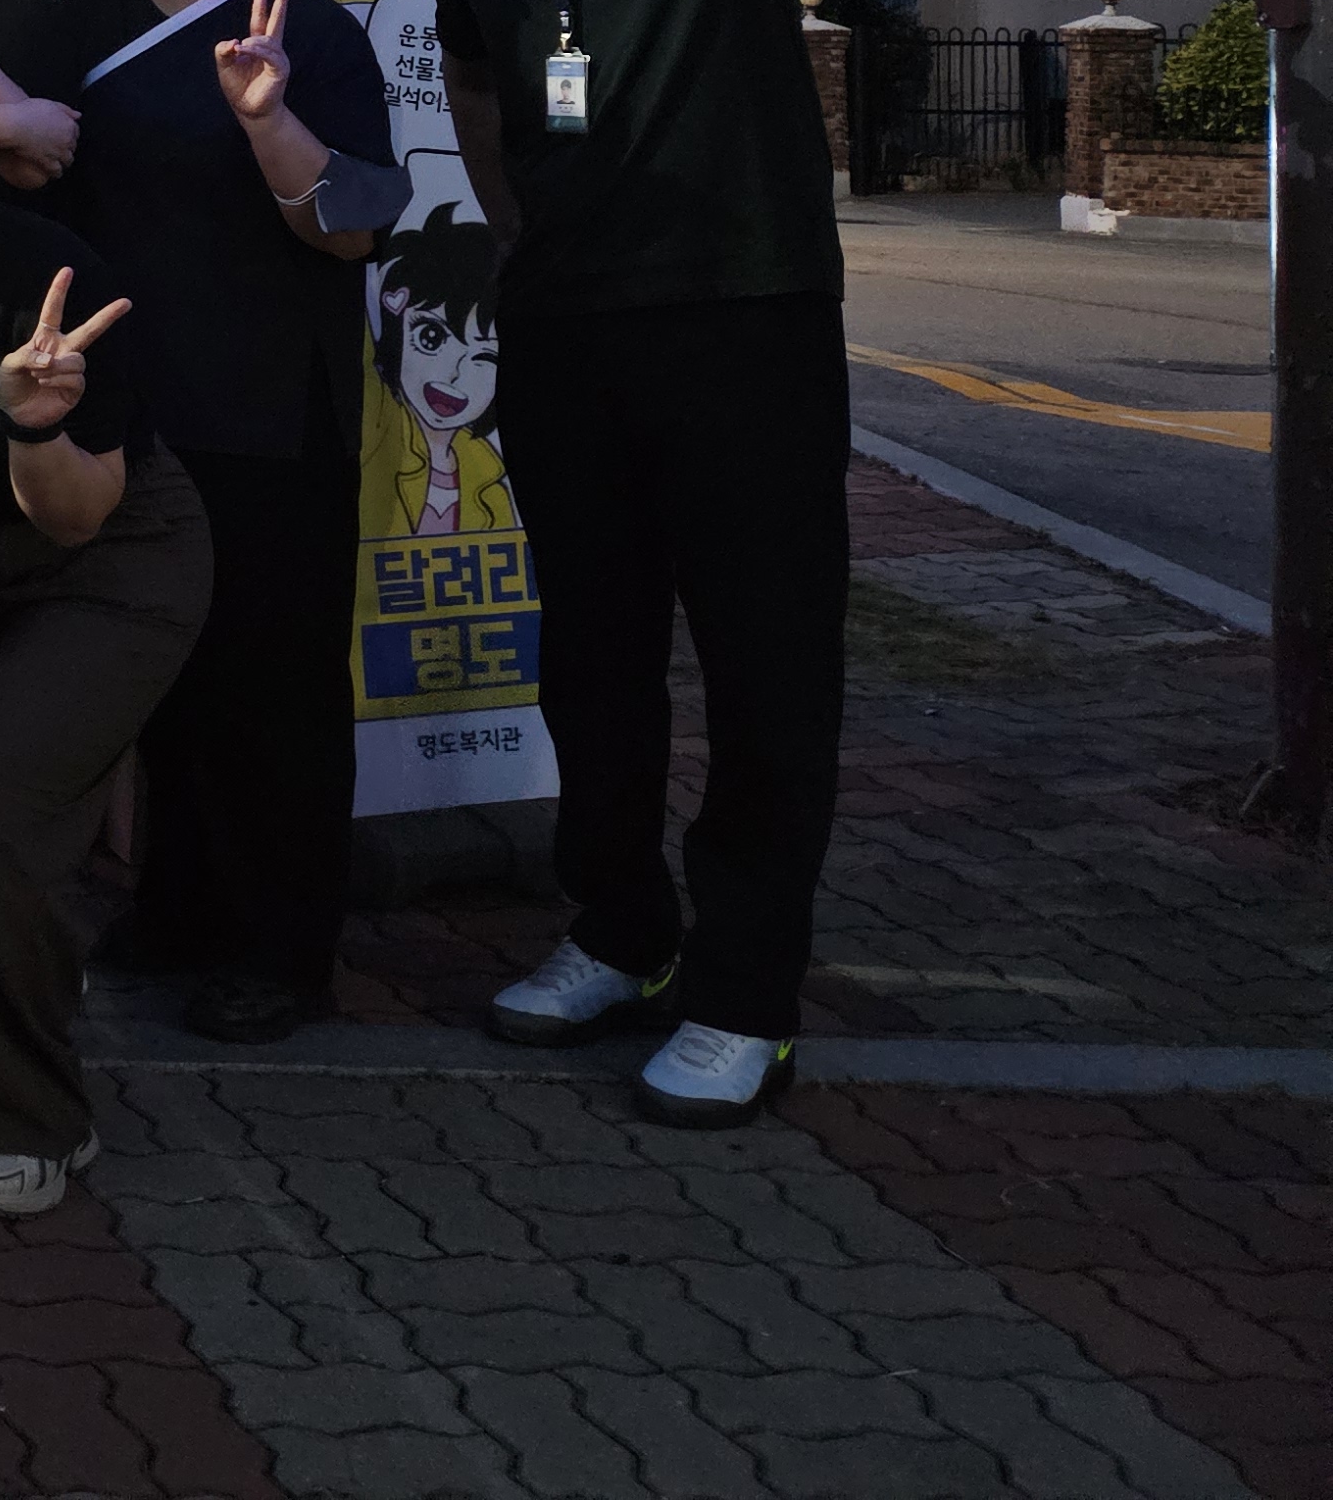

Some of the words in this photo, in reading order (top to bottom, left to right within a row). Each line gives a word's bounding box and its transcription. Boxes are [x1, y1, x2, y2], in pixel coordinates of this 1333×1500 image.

[399, 24, 443, 51] 운동
[410, 619, 522, 690] 명도
[416, 726, 523, 760] 명도복지관
